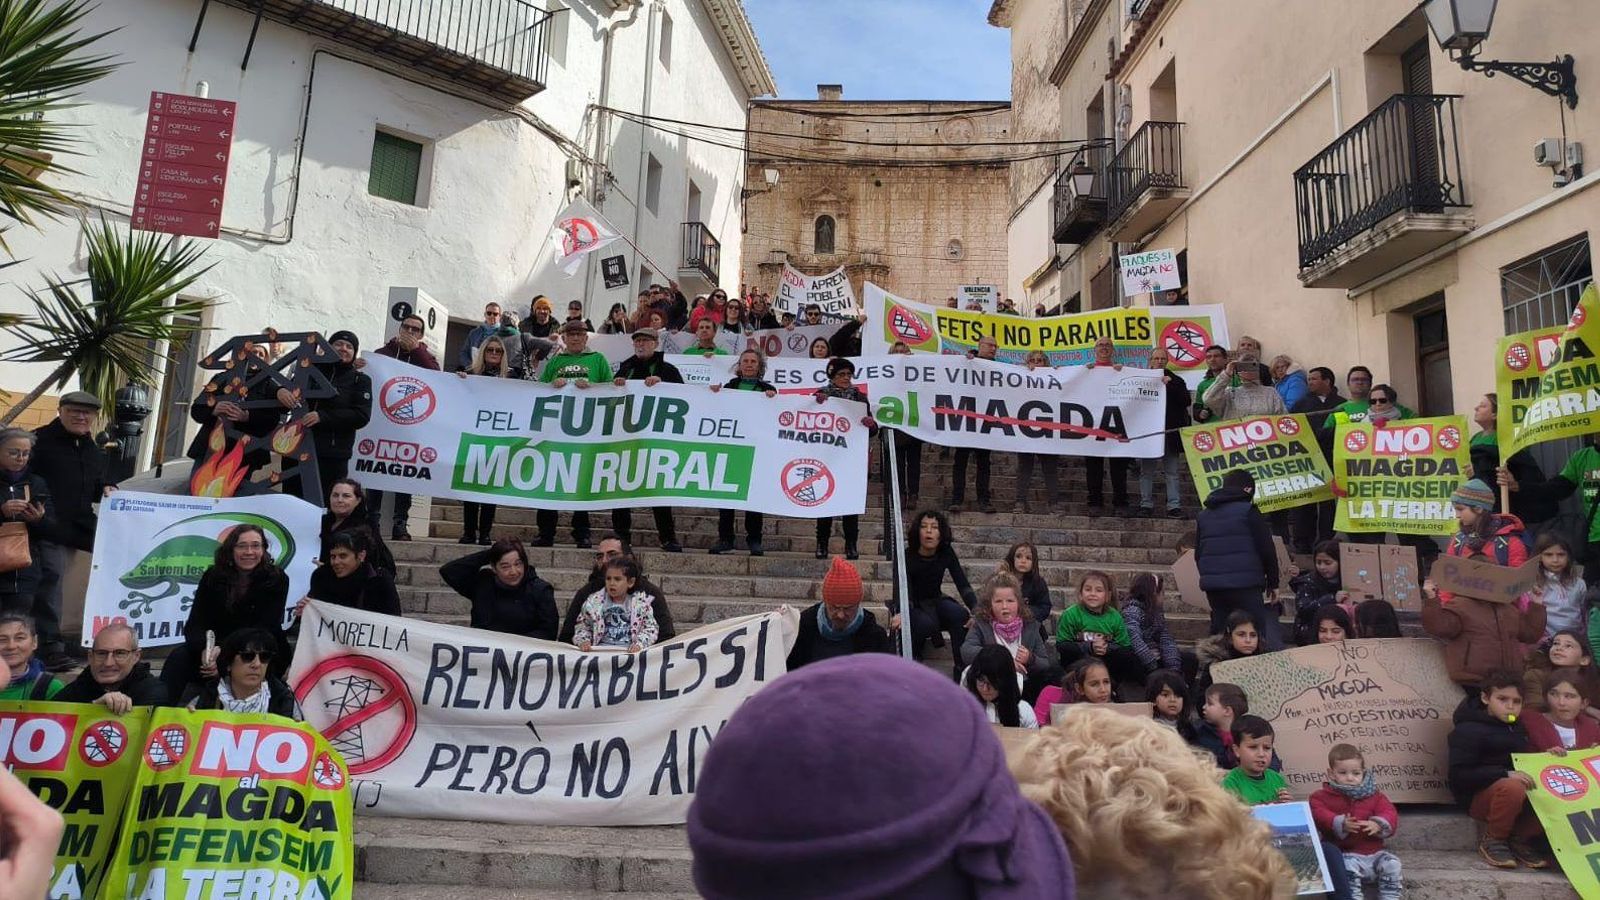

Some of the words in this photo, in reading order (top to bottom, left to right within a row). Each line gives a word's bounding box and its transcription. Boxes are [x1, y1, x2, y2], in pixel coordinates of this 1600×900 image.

[1122, 253, 1160, 267] PLAQUES
[608, 265, 620, 275] NO
[812, 271, 846, 290] APREN
[782, 283, 795, 298] EL
[807, 286, 845, 302] POBLE
[775, 296, 789, 311] NO
[937, 316, 983, 342] FETS
[1004, 325, 1031, 347] NO
[1039, 316, 1150, 347] PARAULES
[747, 335, 782, 357] NO
[565, 364, 581, 372] NO
[904, 366, 936, 383] DE
[686, 374, 711, 382] Terra
[1137, 387, 1159, 397] Terra
[475, 410, 520, 431] PEL
[529, 394, 690, 437] FUTUR
[698, 418, 745, 439] DEL
[798, 412, 834, 430] NO
[875, 391, 920, 428] al
[934, 394, 1131, 442] MAGDA
[1349, 412, 1366, 420] NO
[778, 429, 848, 449] MAGDA
[1220, 421, 1273, 448] NO
[1375, 427, 1432, 452] NO
[379, 442, 416, 460] NO
[1201, 441, 1309, 474] MAGDA
[355, 459, 432, 480] MAGDA
[462, 436, 582, 494] MÓN
[590, 448, 740, 494] RURAL
[1207, 457, 1316, 491] DENSEM
[1345, 458, 1460, 477] MAGDA
[1347, 480, 1459, 498] DEFENSEM
[1348, 500, 1376, 519] LA
[1378, 500, 1457, 519] TERRA
[140, 564, 184, 578] Salvem
[149, 621, 171, 639] LA
[318, 617, 409, 653] MORELLA
[1340, 643, 1369, 660] NO
[423, 638, 707, 711] RENOVABLES
[1345, 664, 1368, 677] AL
[1317, 678, 1383, 701] MAGDA
[1306, 706, 1321, 714] UN
[1322, 701, 1353, 712] NUEVO
[1304, 708, 1440, 730] AUTOGESTIONADO
[199, 726, 308, 775] NO
[1374, 742, 1436, 756] NATURAL
[414, 720, 552, 795] PERÒ
[564, 736, 631, 799] NO
[239, 774, 260, 789] al
[1287, 772, 1328, 783] TENEM
[1371, 765, 1429, 776] APRENDER
[1407, 780, 1423, 791] DE
[137, 782, 339, 833] MAGDA
[128, 827, 335, 872] DEFENSEM
